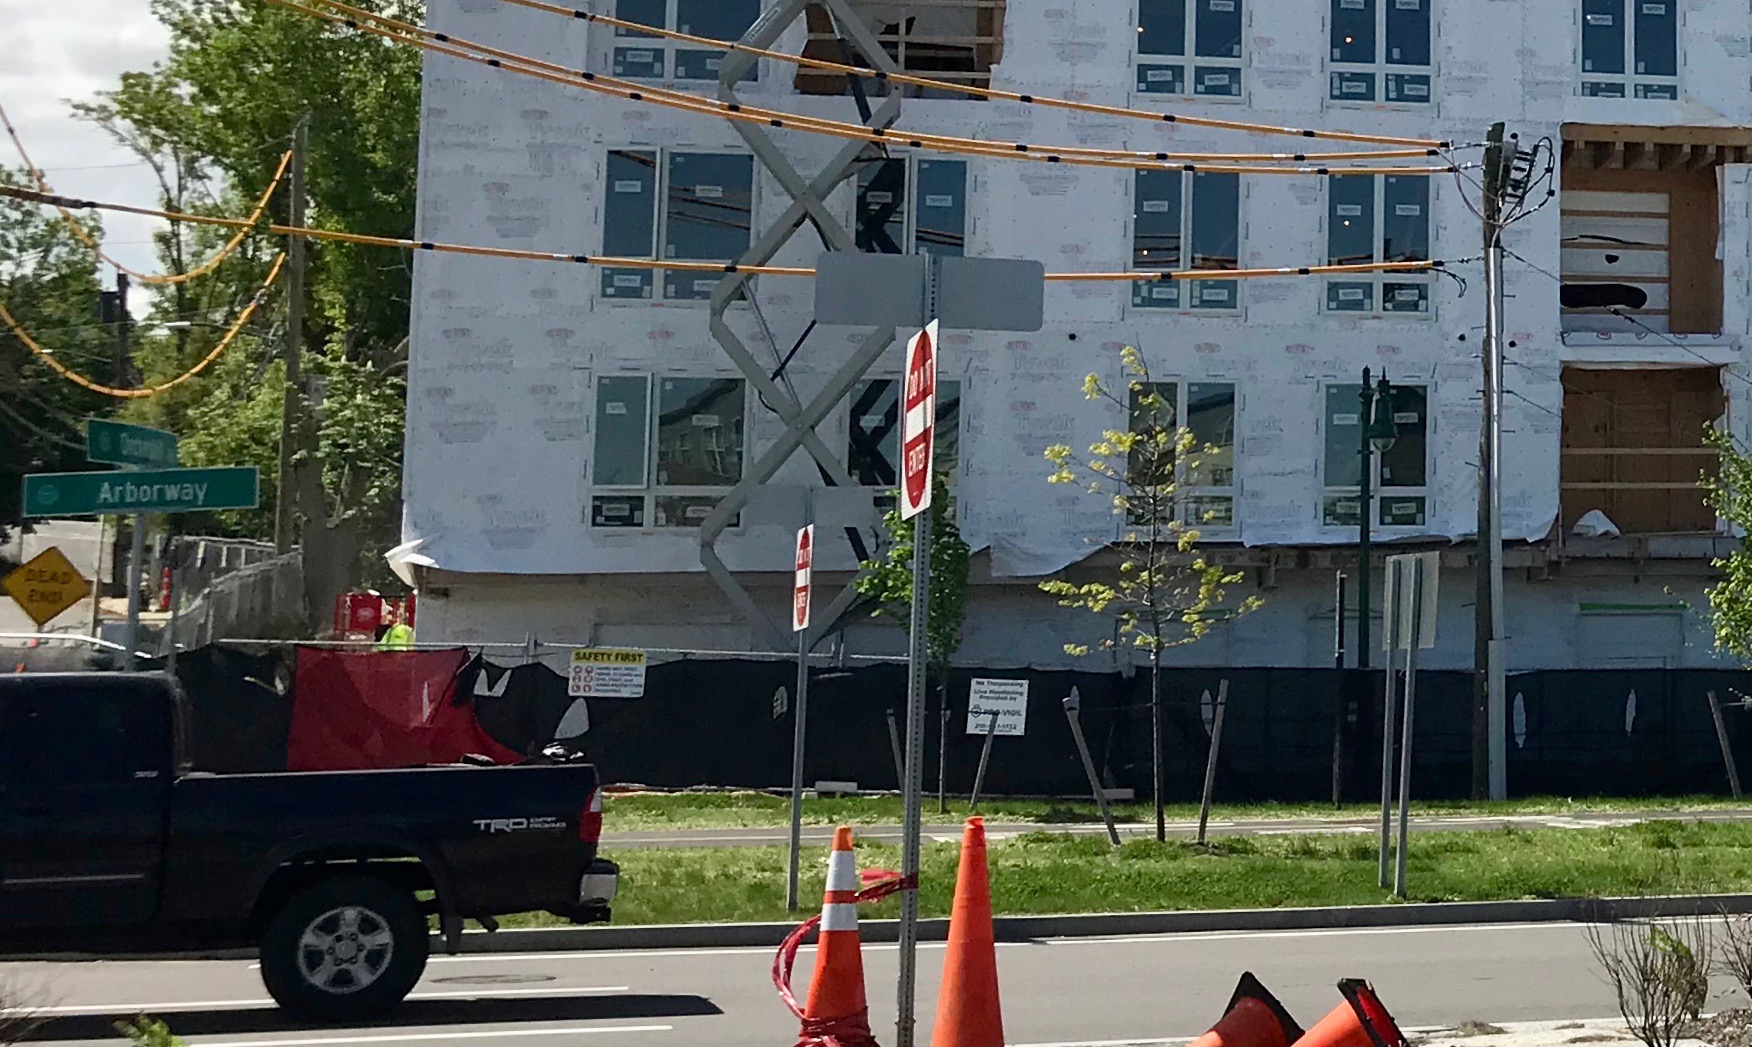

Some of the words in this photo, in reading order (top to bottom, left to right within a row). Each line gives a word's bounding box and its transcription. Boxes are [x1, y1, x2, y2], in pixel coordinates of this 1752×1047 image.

[99, 481, 208, 505] Arborway
[23, 567, 72, 585] DEAD
[26, 588, 64, 603] END
[574, 652, 612, 661] SAFETY
[614, 653, 644, 663] FIRST
[473, 818, 528, 832] TRD
